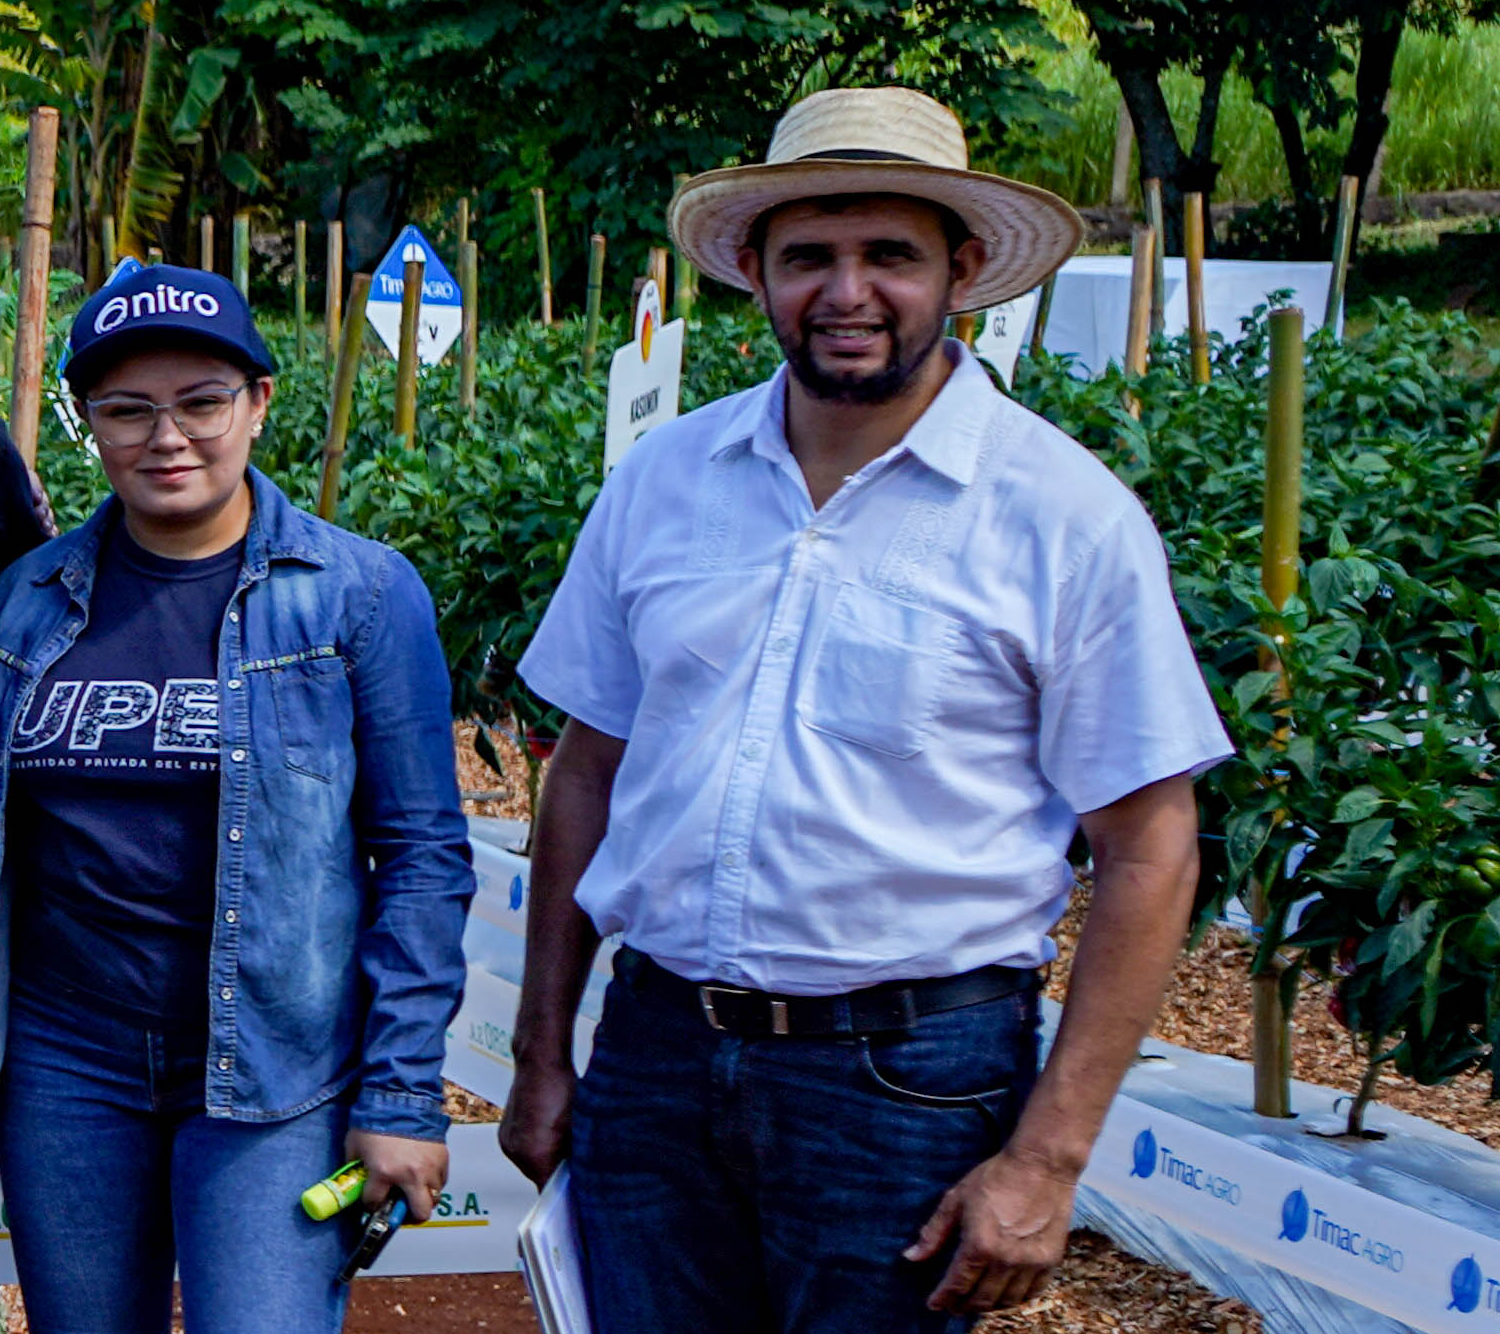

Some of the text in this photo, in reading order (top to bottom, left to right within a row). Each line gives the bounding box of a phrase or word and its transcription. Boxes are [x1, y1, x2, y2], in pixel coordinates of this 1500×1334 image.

[132, 283, 220, 318] nitro
[9, 678, 219, 754] UPE
[190, 760, 218, 771] EST
[1160, 1147, 1242, 1207] Timac AGRO
[1313, 1208, 1404, 1273] Timac AGRO
